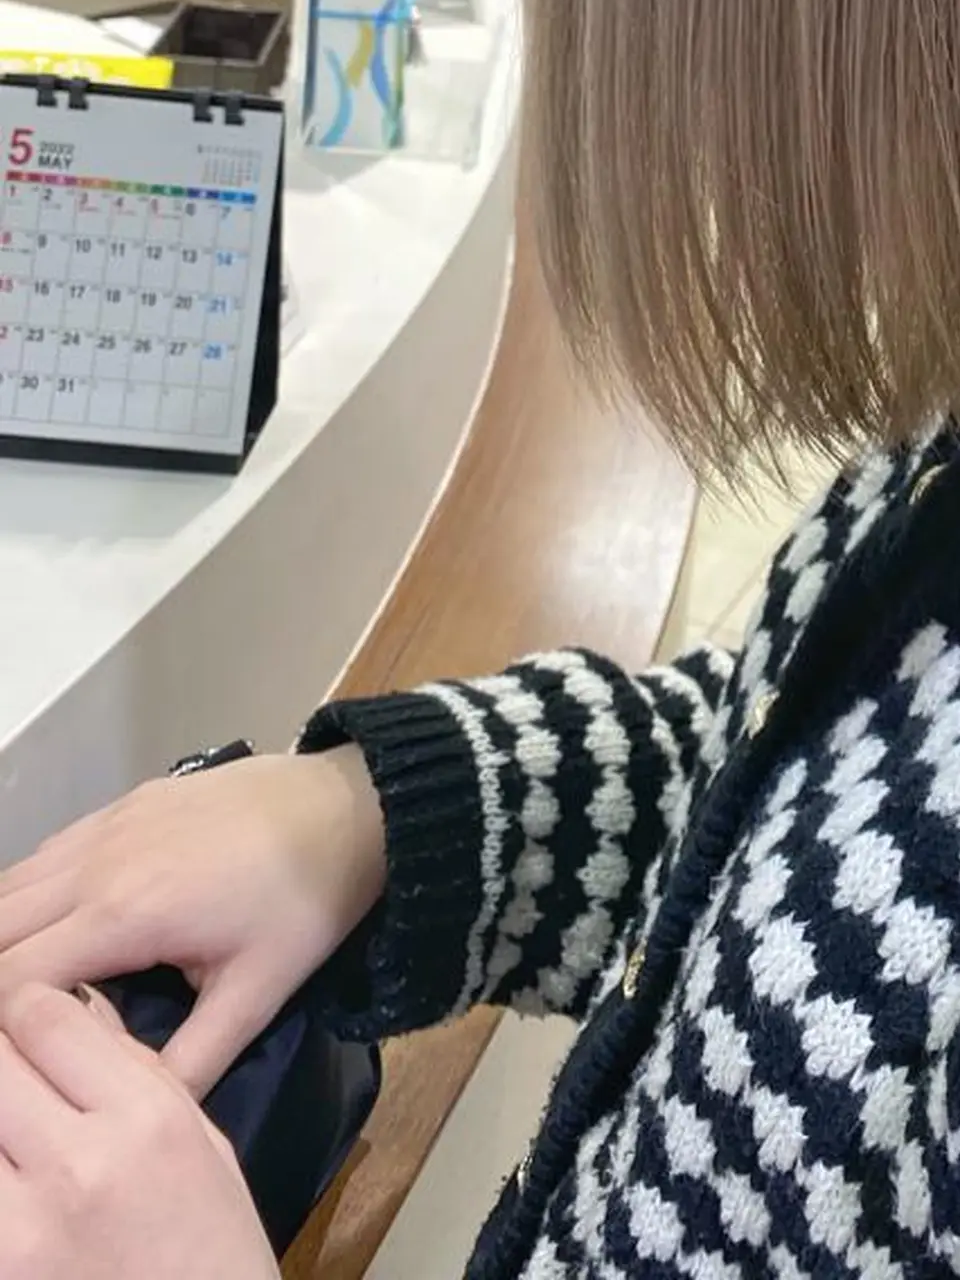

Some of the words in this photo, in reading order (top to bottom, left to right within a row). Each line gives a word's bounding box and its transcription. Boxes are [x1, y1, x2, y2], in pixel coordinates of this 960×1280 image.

[8, 127, 35, 166] 5
[40, 141, 75, 154] 2022
[38, 155, 73, 170] MAY
[43, 187, 53, 202] 2
[38, 234, 48, 249] 9
[75, 238, 92, 254] 10
[111, 241, 126, 258] 11
[146, 245, 163, 261] 12
[182, 248, 199, 264] 13
[216, 250, 234, 267] 14
[34, 280, 50, 297] 16
[70, 284, 87, 300] 17
[106, 288, 122, 305] 18
[141, 291, 157, 307] 19
[175, 294, 193, 310] 20
[208, 297, 228, 314] 21
[26, 327, 44, 343] 23
[61, 331, 81, 346] 24
[97, 334, 116, 350] 25
[133, 337, 152, 354] 26
[168, 340, 188, 356] 27
[203, 343, 222, 361] 28
[20, 375, 39, 391] 30
[57, 377, 75, 393] 31
